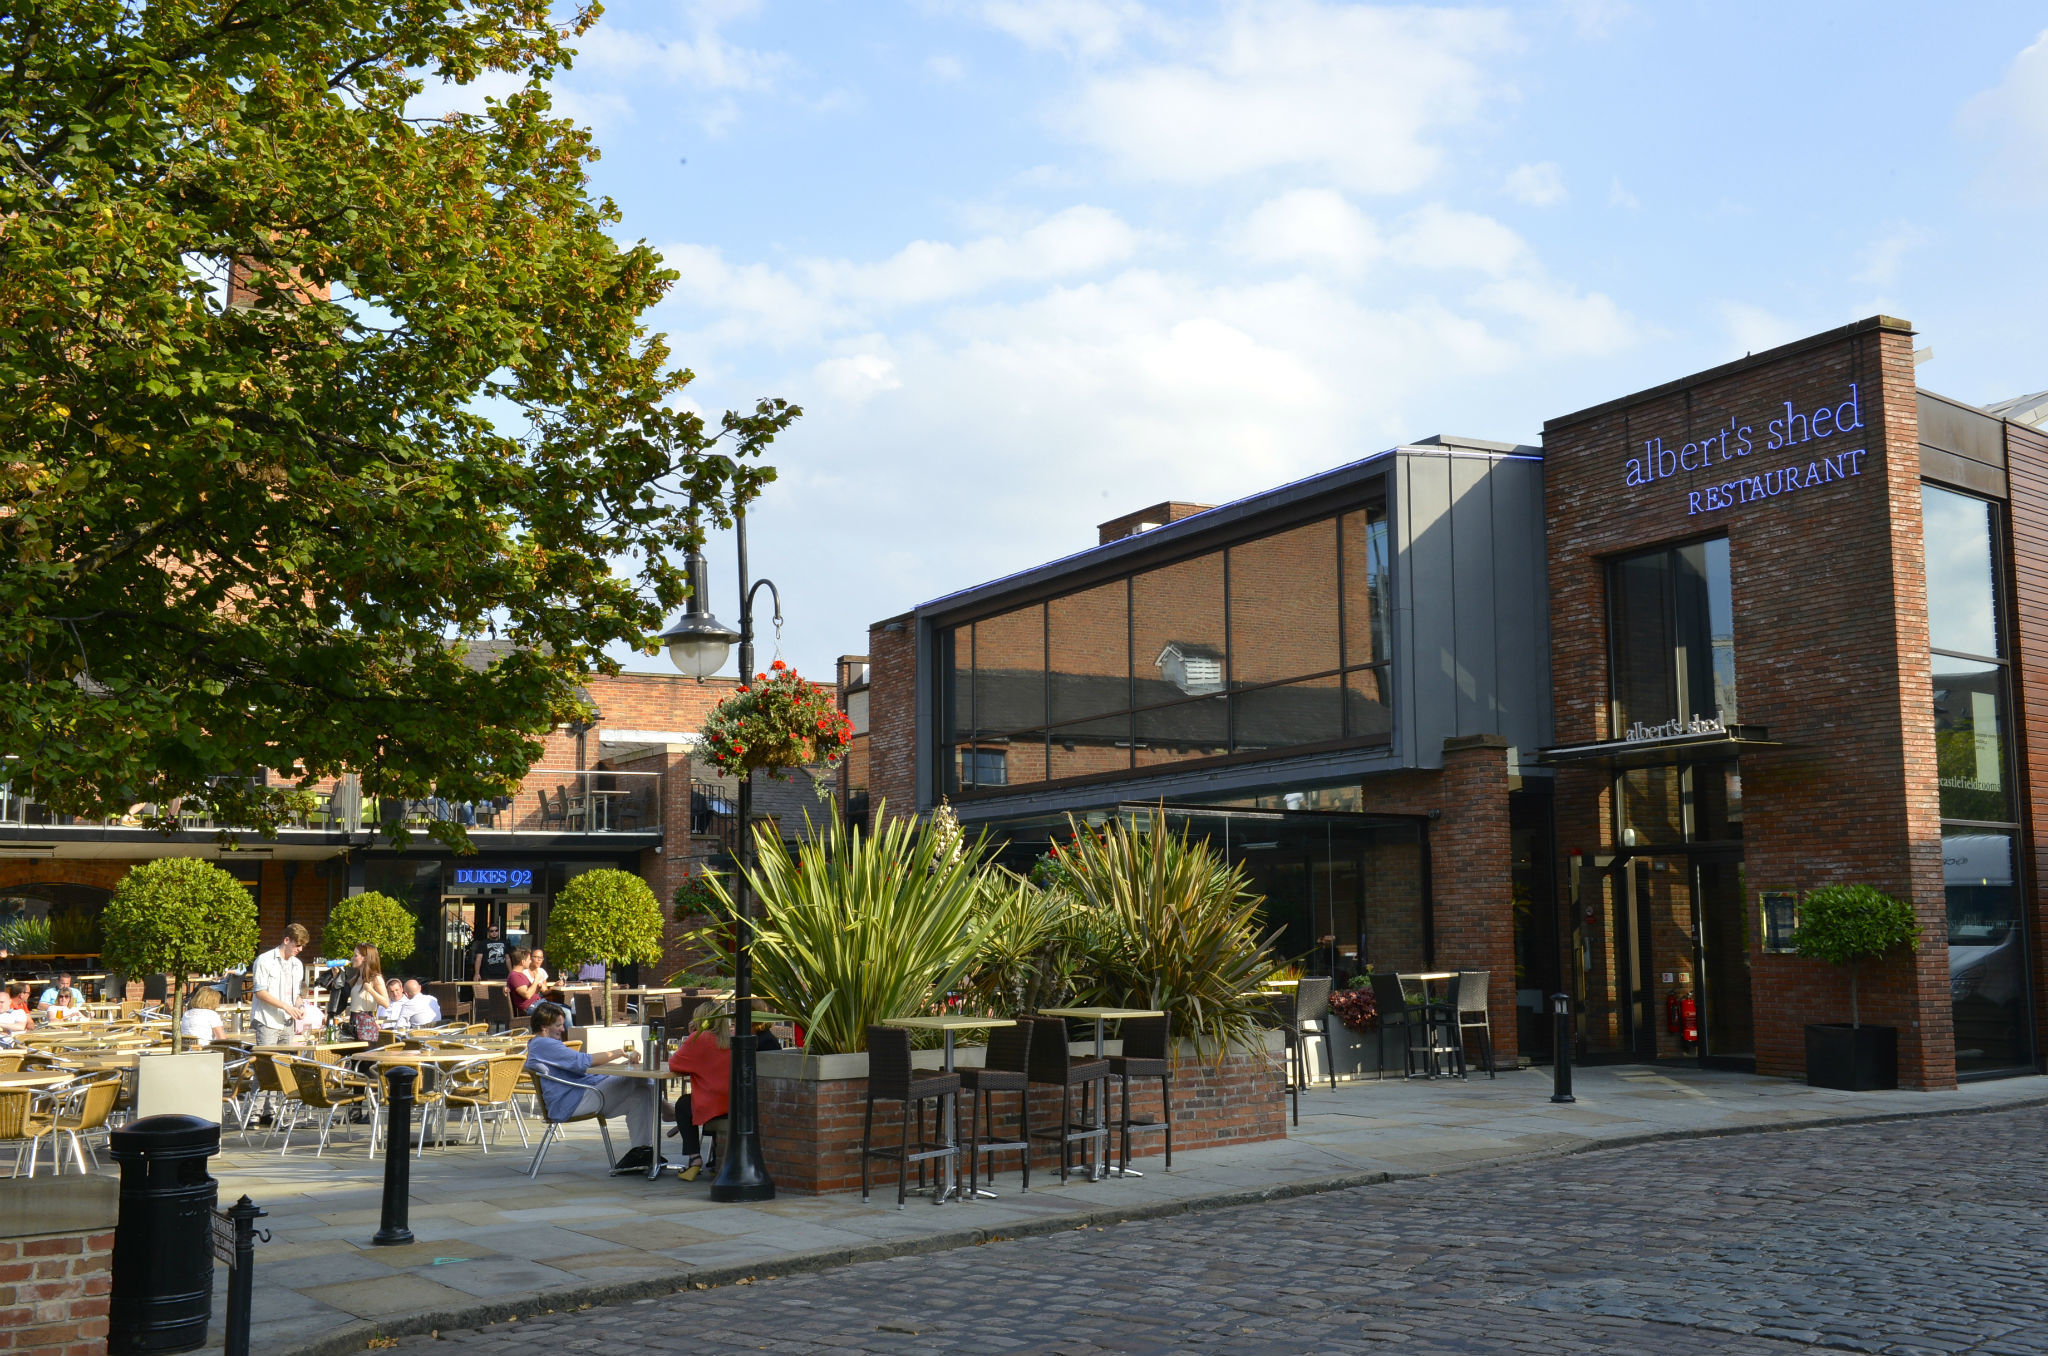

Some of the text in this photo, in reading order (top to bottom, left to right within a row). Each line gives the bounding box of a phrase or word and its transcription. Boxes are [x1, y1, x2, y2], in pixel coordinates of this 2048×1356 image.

[1626, 383, 1865, 487] albert's shed
[1688, 449, 1866, 515] RESTAURANT
[1626, 710, 1726, 742] albert's shed
[457, 869, 532, 888] DUKES 92
